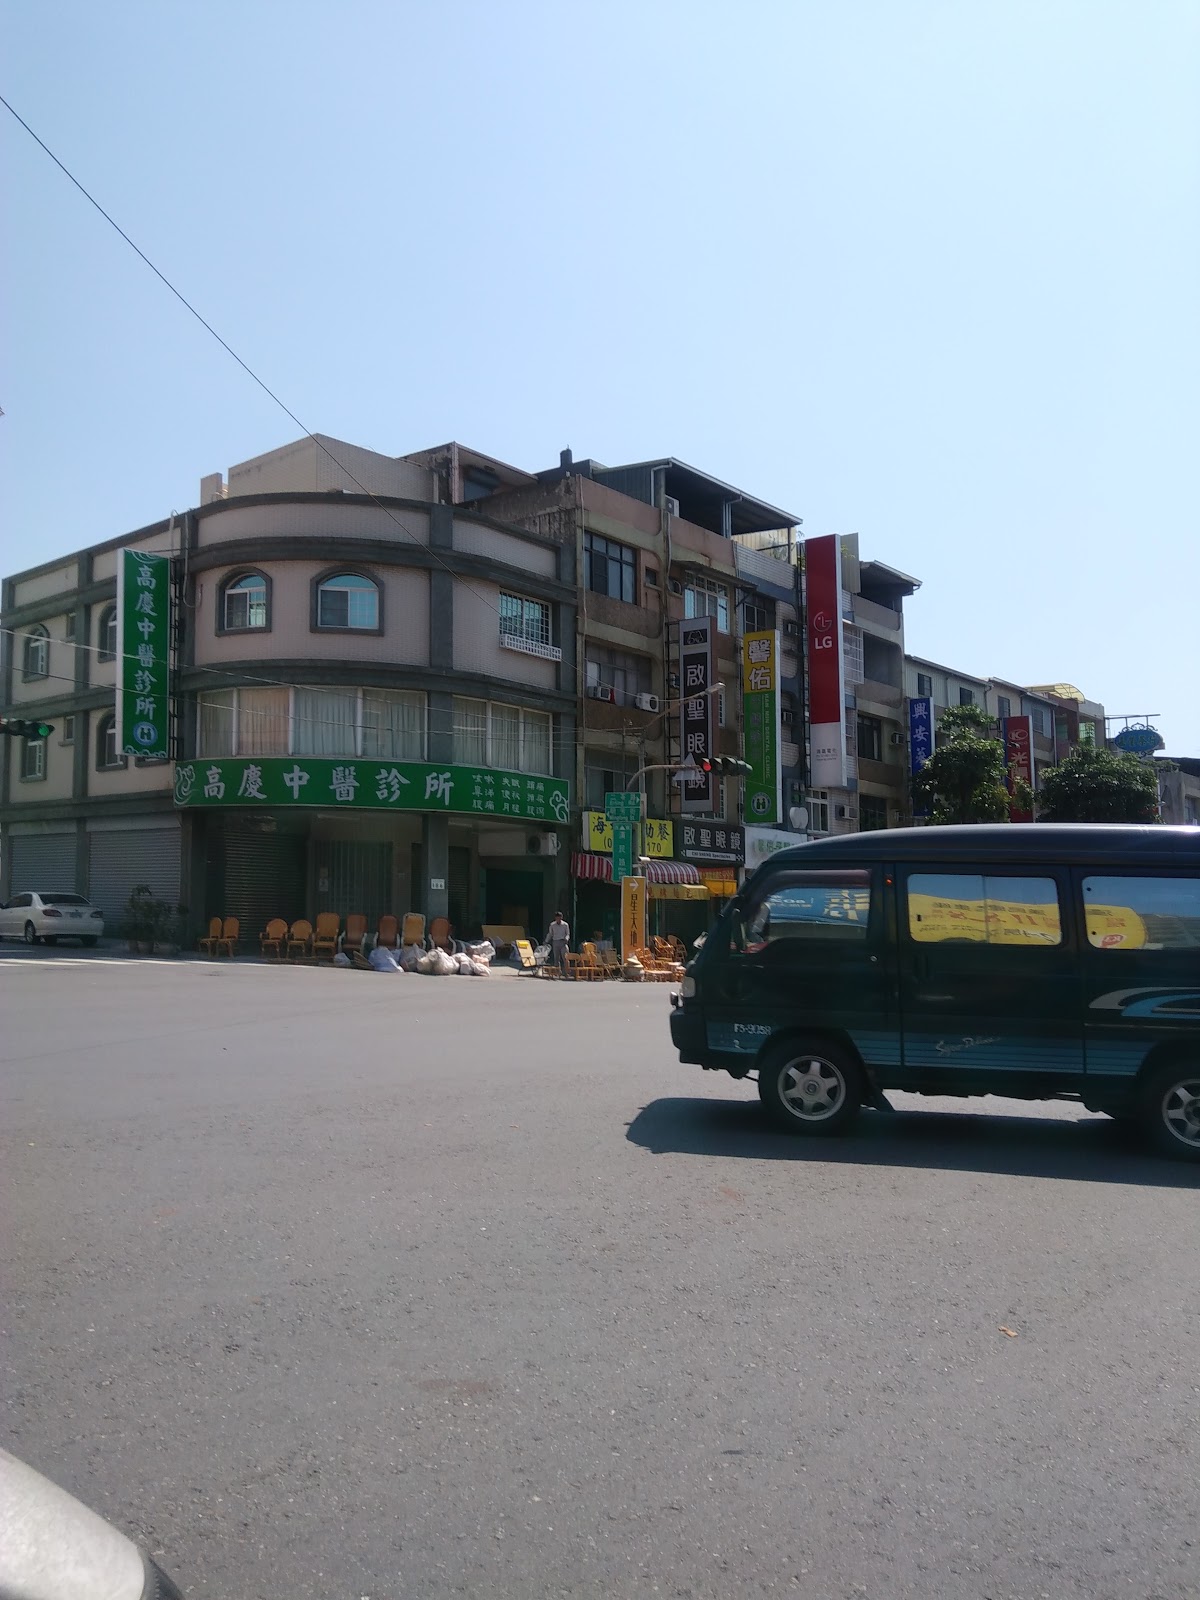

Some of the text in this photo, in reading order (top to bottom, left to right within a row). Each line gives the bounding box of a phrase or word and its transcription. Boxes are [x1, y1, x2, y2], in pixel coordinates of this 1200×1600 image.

[135, 564, 158, 720] 高慶中醫診所
[814, 635, 833, 650] LG
[203, 763, 455, 806] 高慶中醫診所
